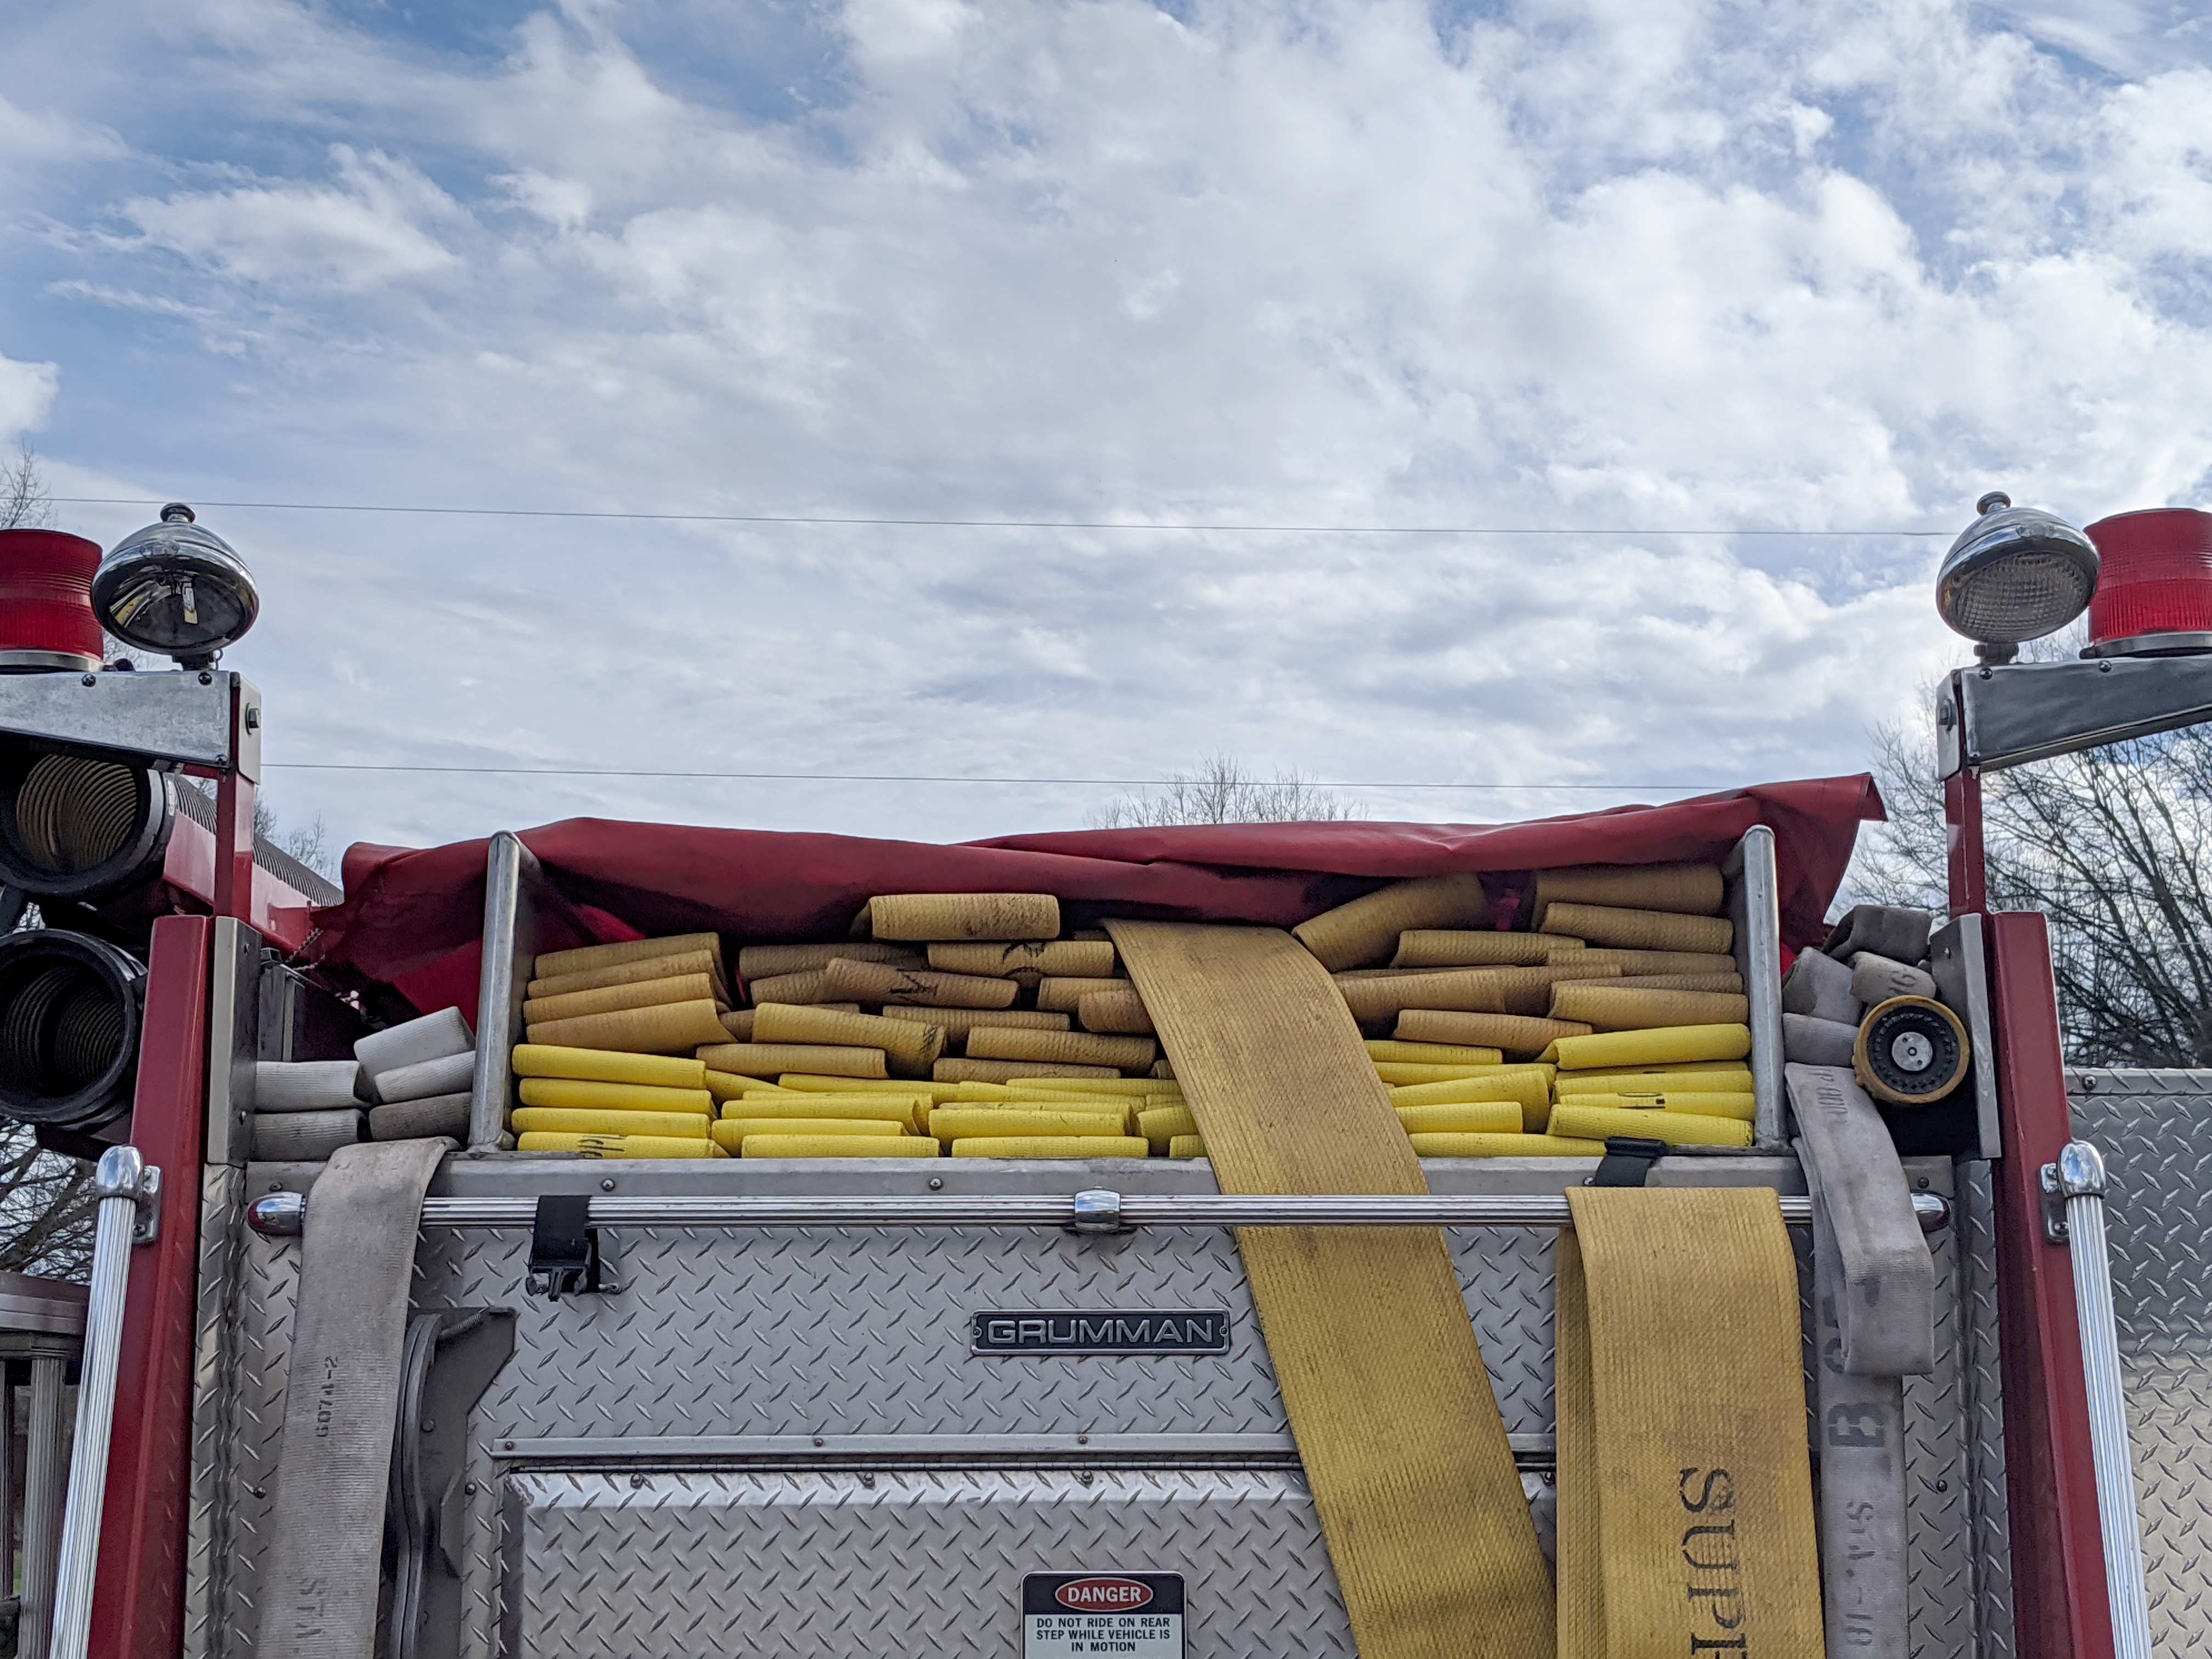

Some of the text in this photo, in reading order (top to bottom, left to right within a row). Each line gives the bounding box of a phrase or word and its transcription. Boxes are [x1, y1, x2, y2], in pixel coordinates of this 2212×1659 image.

[988, 1319, 1212, 1345] GRUMMAN
[1068, 1587, 1142, 1602] DANGER
[1037, 1617, 1170, 1628] DO NOT RIDE ON REAR
[1036, 1629, 1170, 1640] STEP WHILE VEHICLE IS
[1071, 1642, 1136, 1652] IN MOTION
